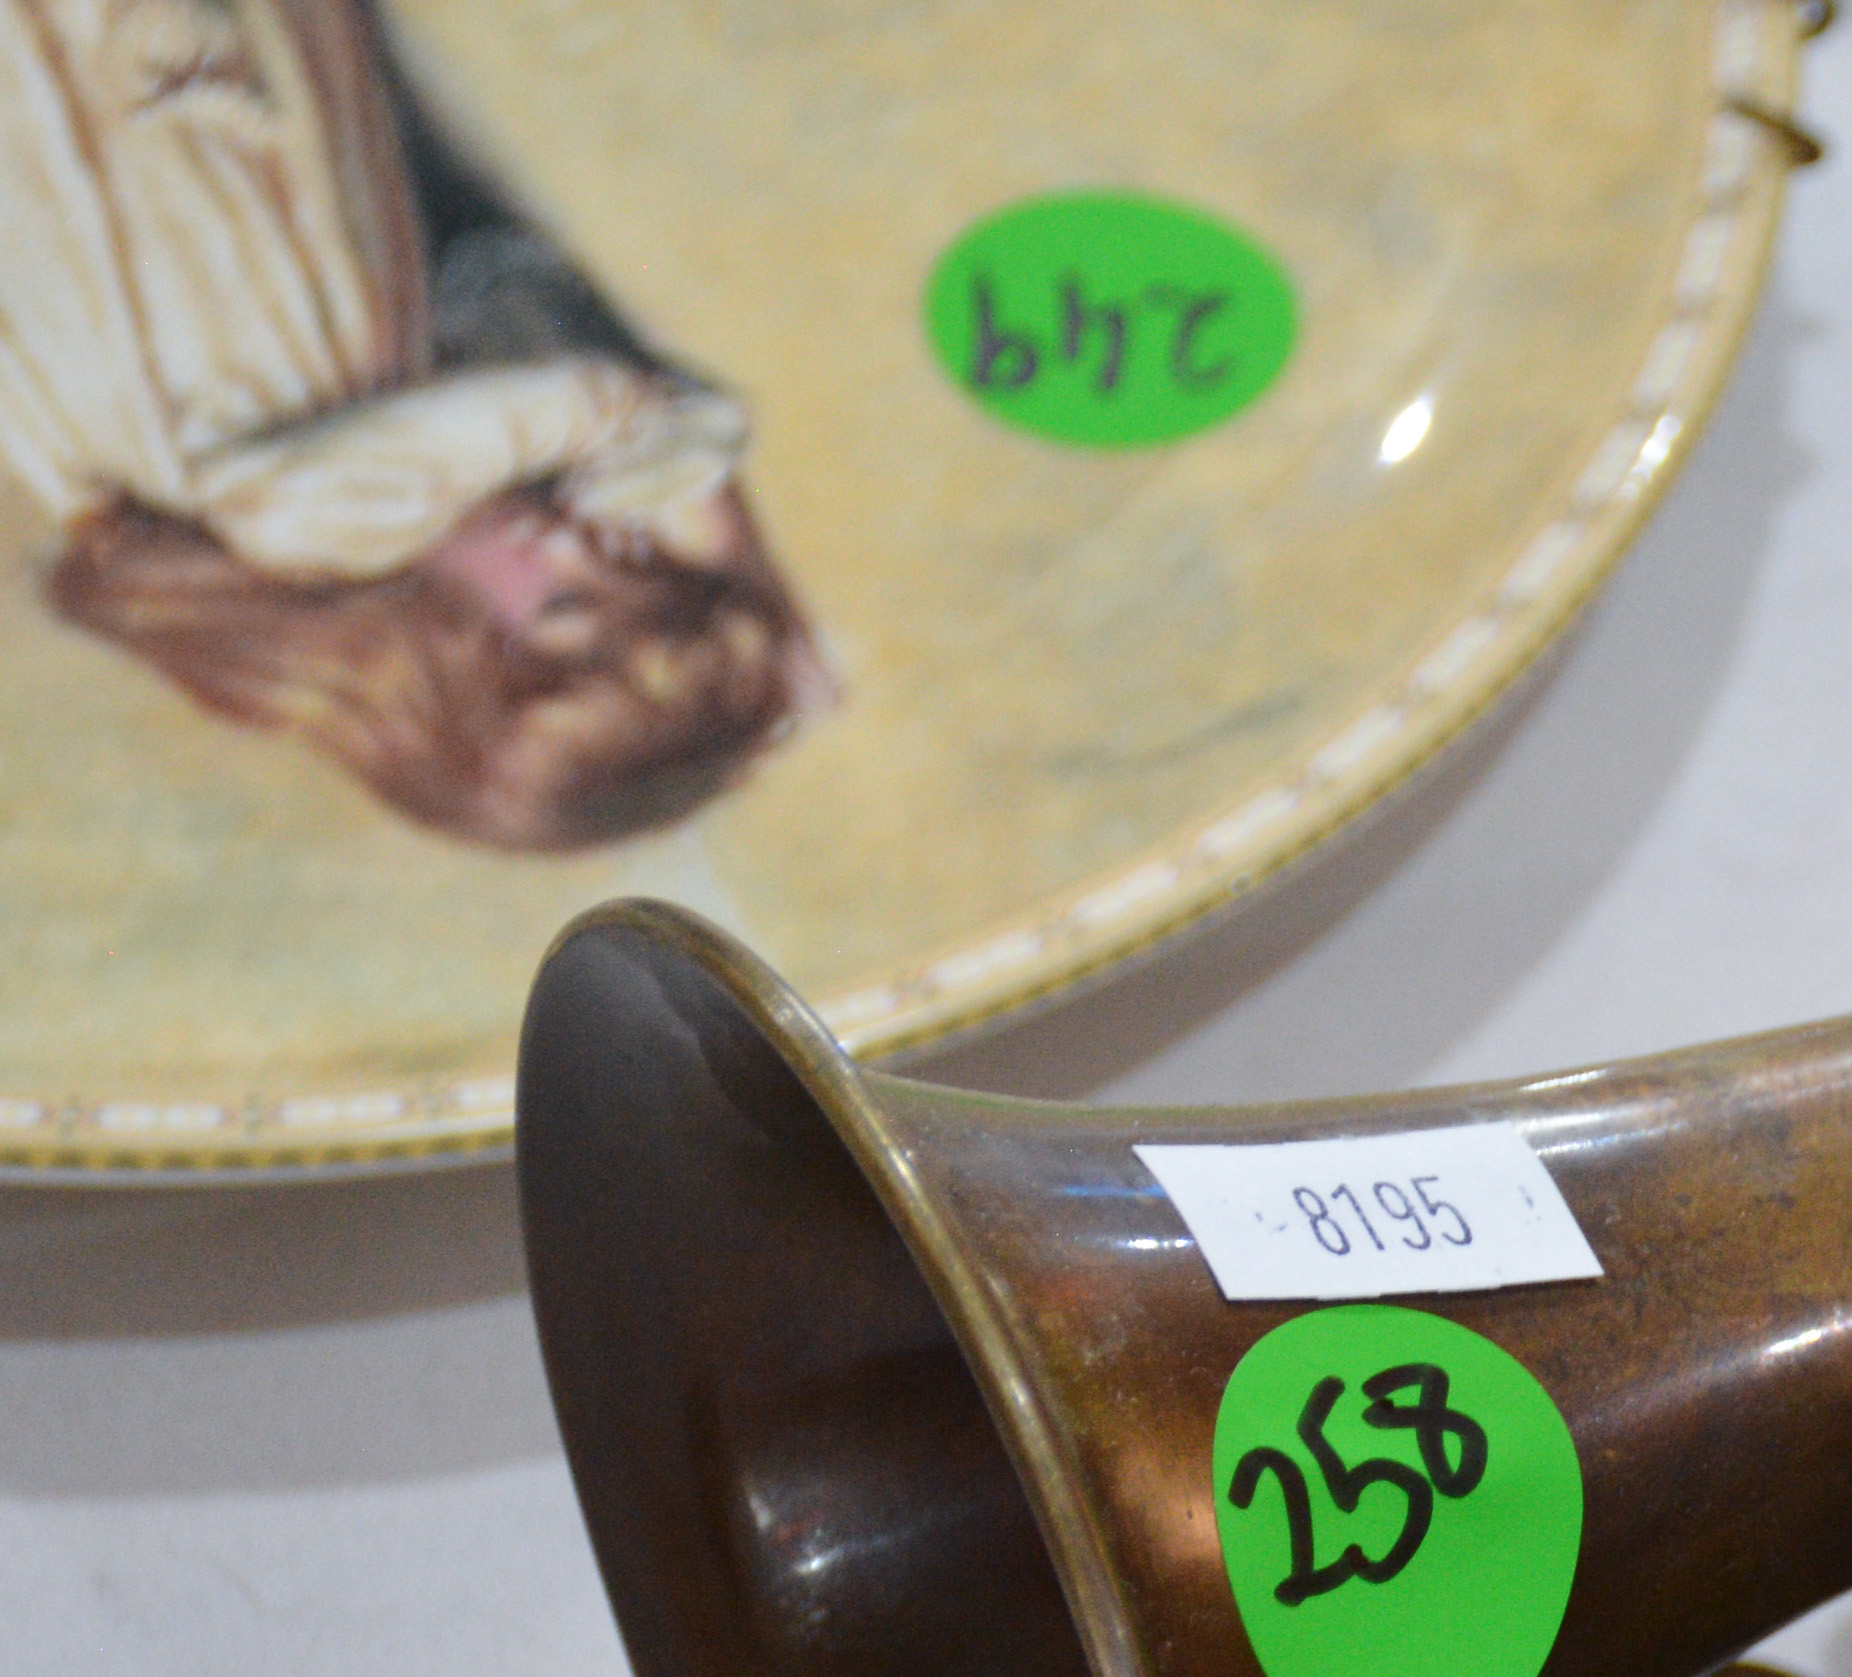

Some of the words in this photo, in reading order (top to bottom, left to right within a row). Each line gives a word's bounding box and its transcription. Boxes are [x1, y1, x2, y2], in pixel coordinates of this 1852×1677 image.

[966, 266, 1238, 400] 249
[1293, 1174, 1473, 1257] 8195
[1227, 1361, 1489, 1608] 258
